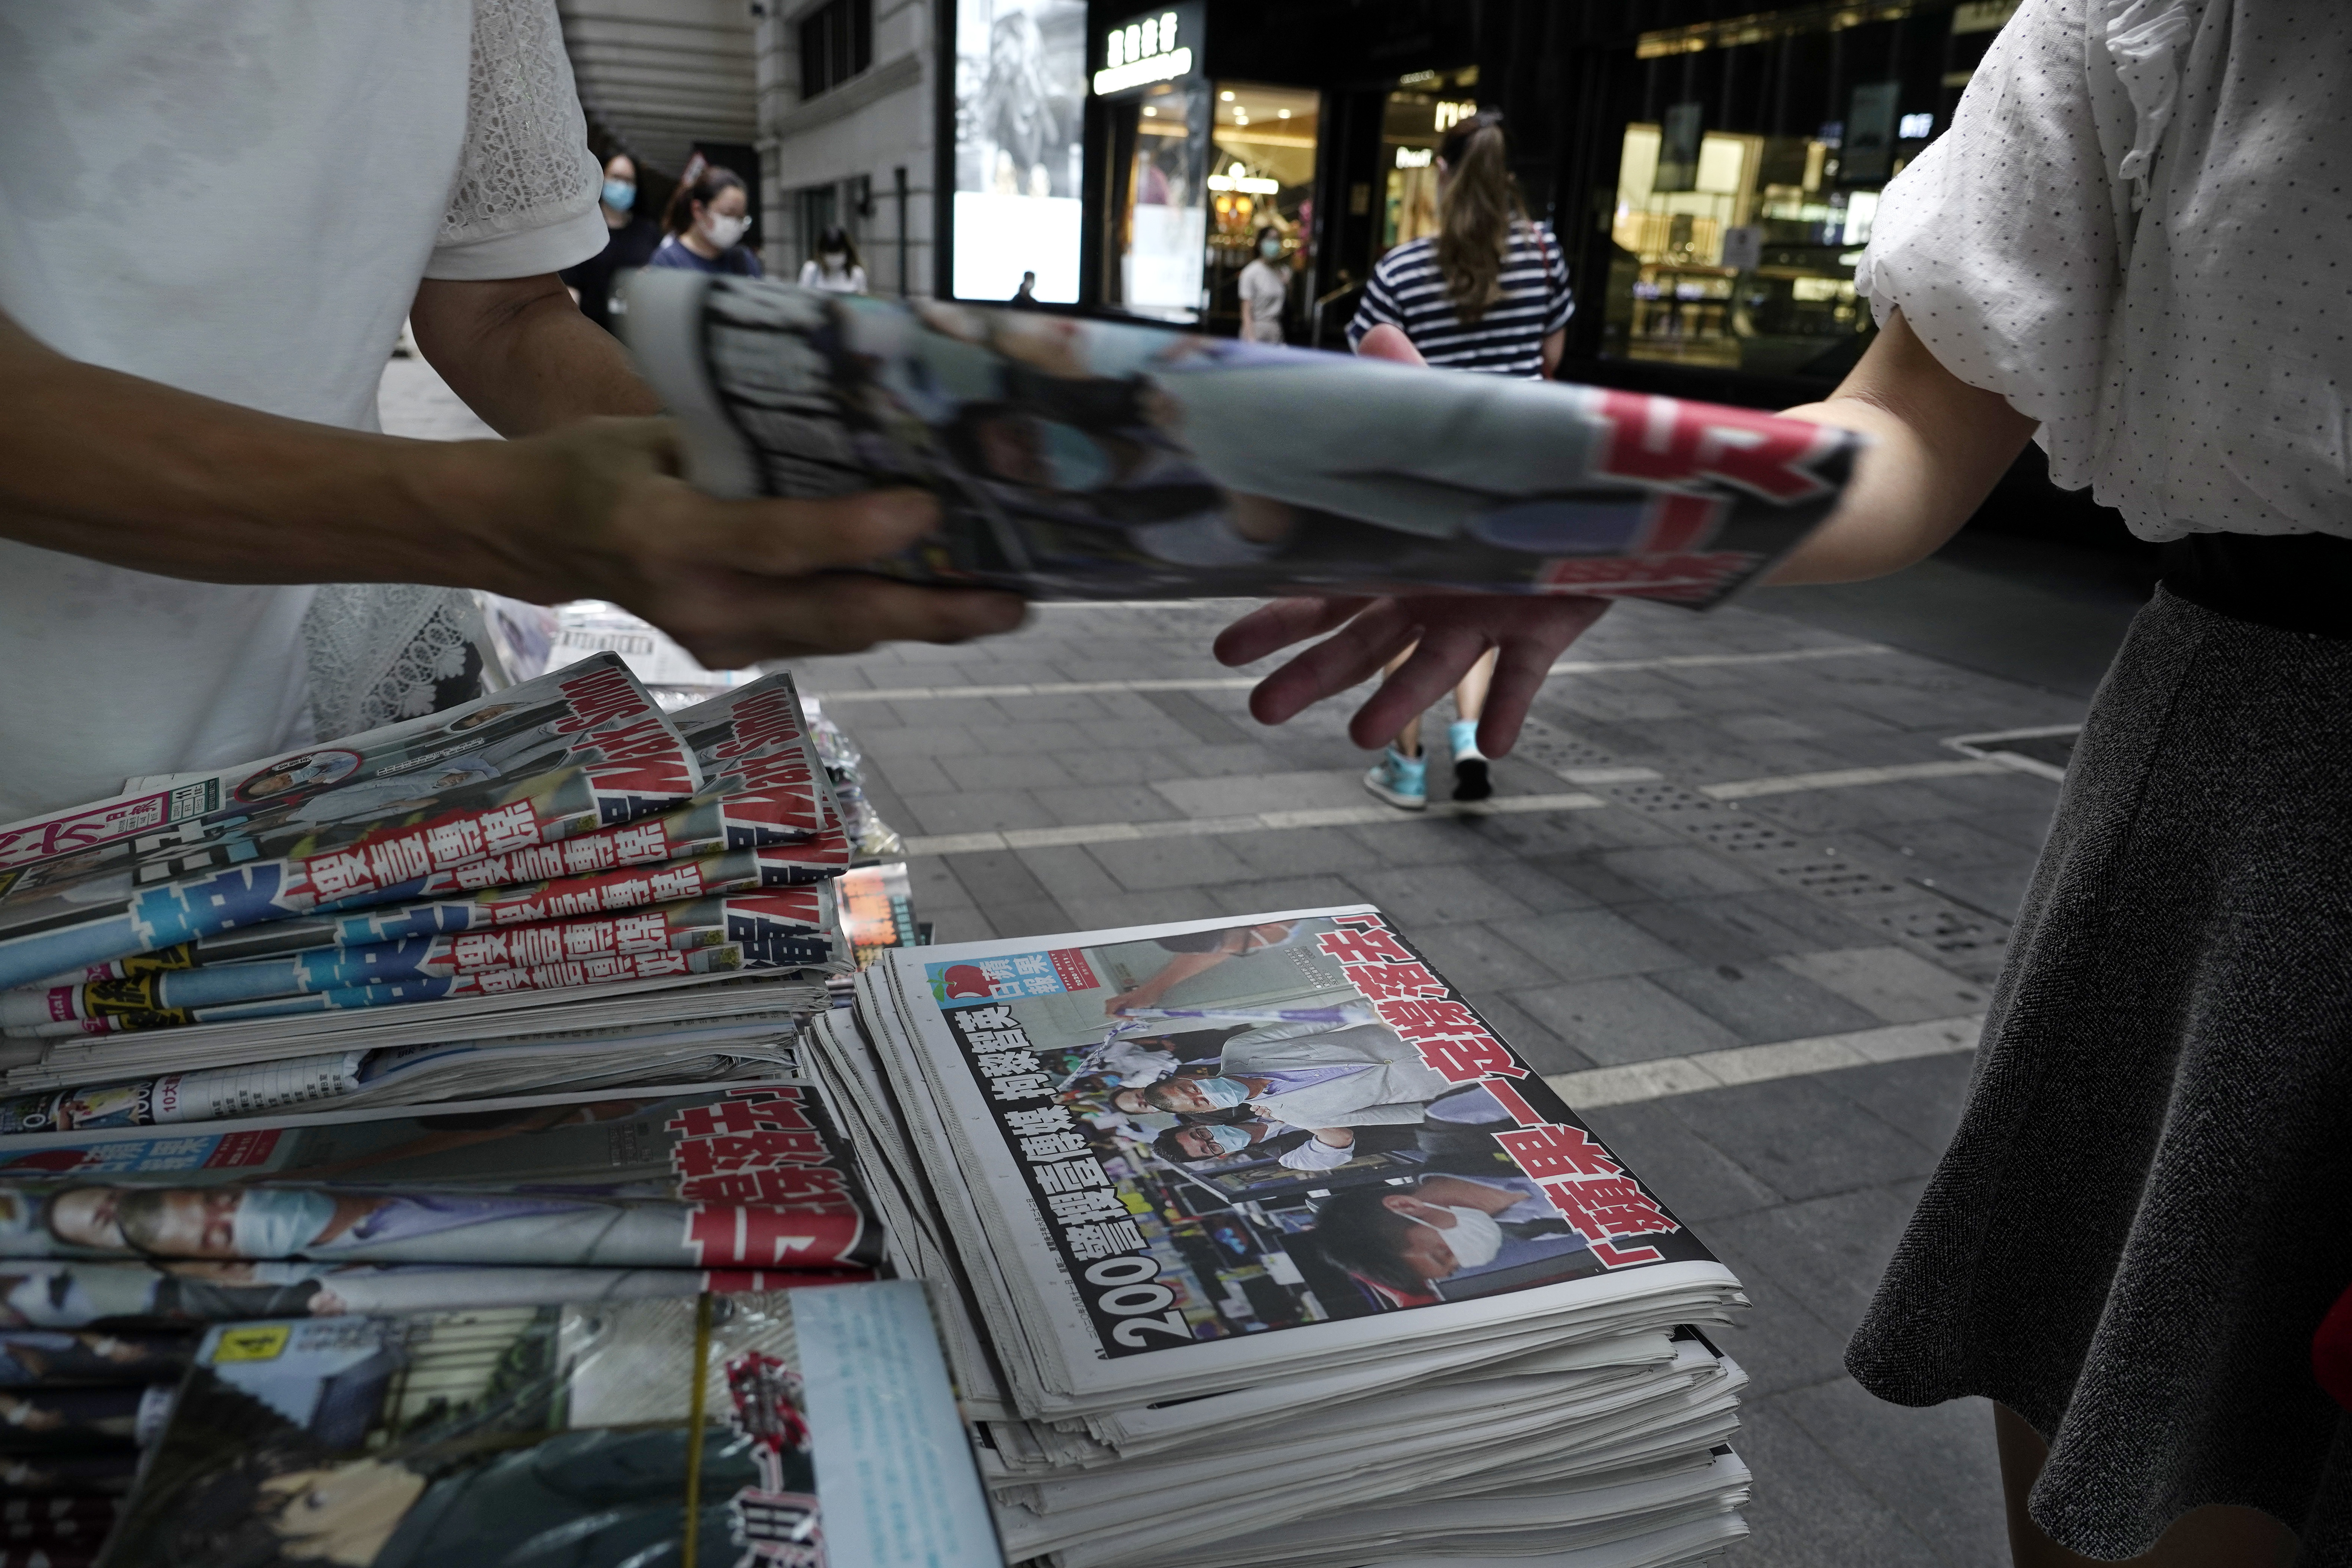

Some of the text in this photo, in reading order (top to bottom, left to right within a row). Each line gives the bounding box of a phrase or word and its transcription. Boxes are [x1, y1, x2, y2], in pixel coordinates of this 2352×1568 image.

[556, 667, 650, 733] Simon
[716, 688, 800, 758] Simon
[571, 718, 693, 794] Mark
[176, 789, 192, 799] 11
[718, 747, 817, 829] Mark
[979, 954, 1050, 981] 蘋果
[988, 975, 1060, 1000] 日報
[1051, 953, 1073, 989] APPLE DAILY
[955, 1004, 1058, 1103] 拘黎智英
[1315, 913, 1681, 1269] 「蘋果一定撐落去」
[1055, 1257, 1069, 1273] 星期二
[1095, 1348, 1109, 1360] A1
